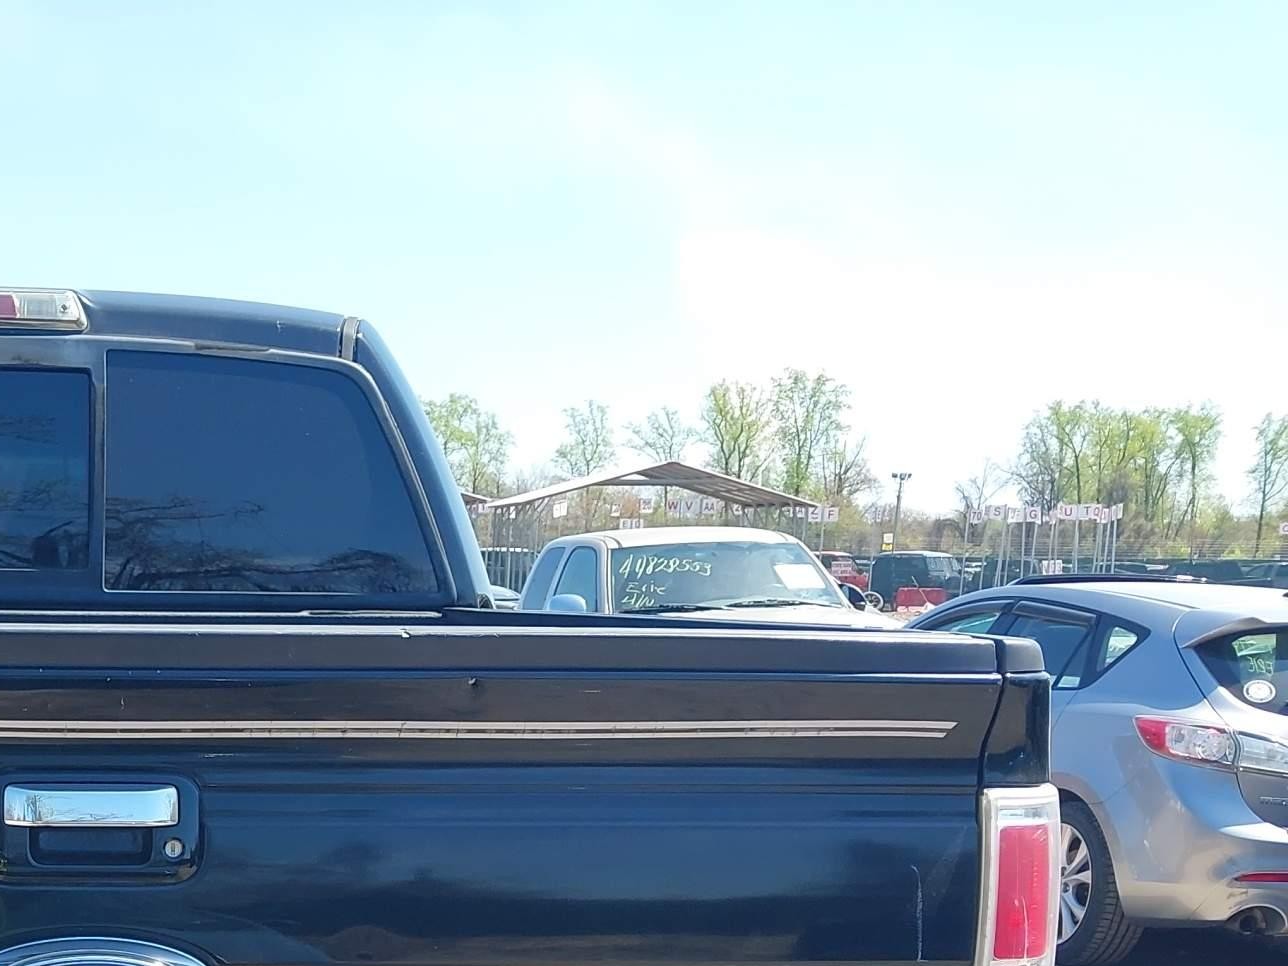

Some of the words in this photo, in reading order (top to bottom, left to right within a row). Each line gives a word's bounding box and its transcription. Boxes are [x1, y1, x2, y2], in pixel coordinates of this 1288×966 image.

[668, 501, 679, 511] W
[685, 501, 694, 511] V
[1029, 509, 1038, 519] G
[1064, 507, 1073, 516] U
